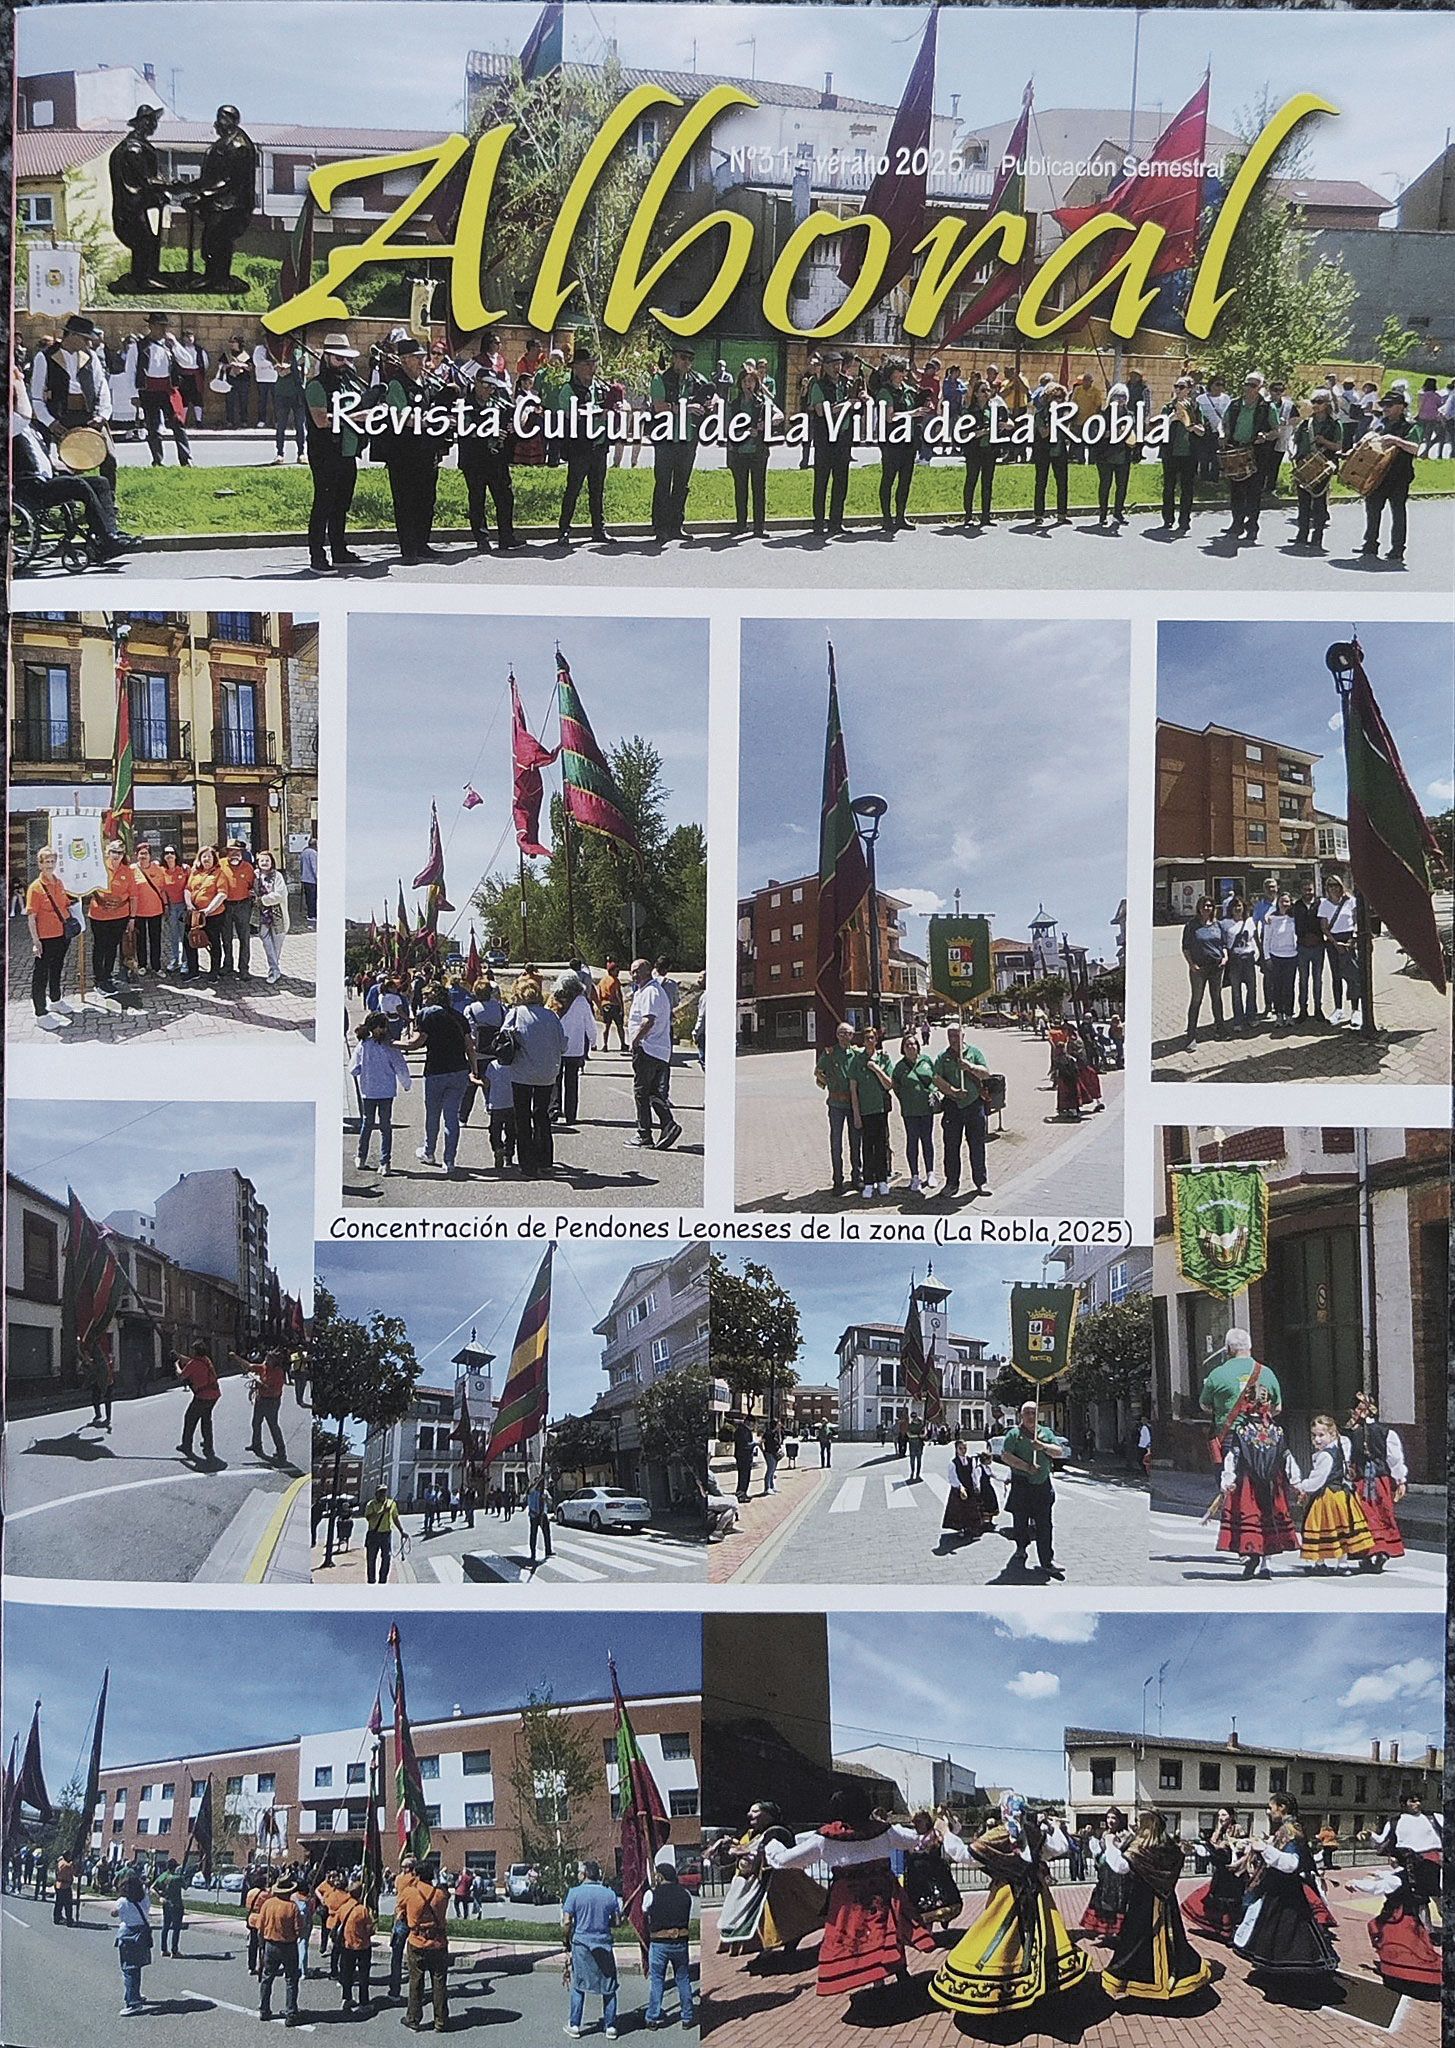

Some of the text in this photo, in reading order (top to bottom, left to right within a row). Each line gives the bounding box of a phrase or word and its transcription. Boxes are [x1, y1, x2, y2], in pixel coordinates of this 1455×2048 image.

[815, 152, 890, 176] verano
[895, 147, 964, 177] 2025
[1001, 154, 1225, 179] Publicación Semestral
[261, 84, 1341, 339] Alboral
[331, 390, 1171, 445] Revista Cultural de La Villa de La Robla
[329, 1215, 1134, 1249] Concentración de Pendones Leoneses de la zona (La Robla,2025)
